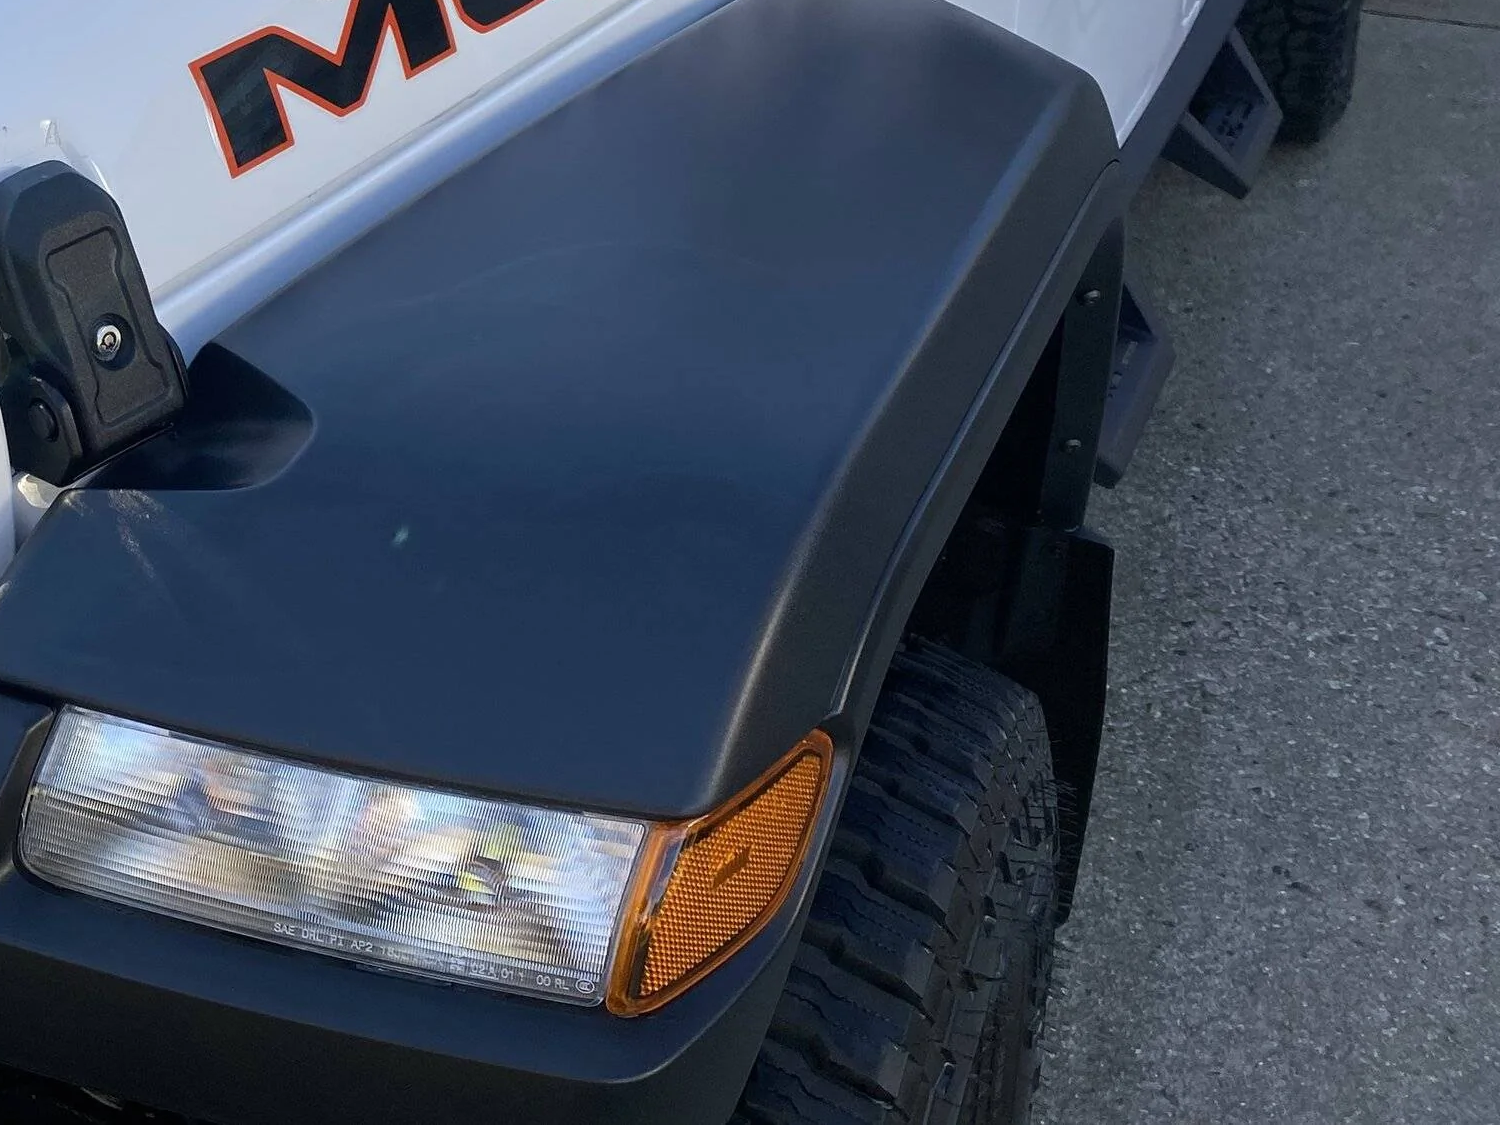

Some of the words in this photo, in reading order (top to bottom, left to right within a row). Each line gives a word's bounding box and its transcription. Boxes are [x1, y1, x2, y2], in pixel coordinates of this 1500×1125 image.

[273, 922, 296, 936] SAE
[301, 928, 324, 943] DRL
[351, 940, 373, 953] AP2
[555, 978, 569, 990] RL
